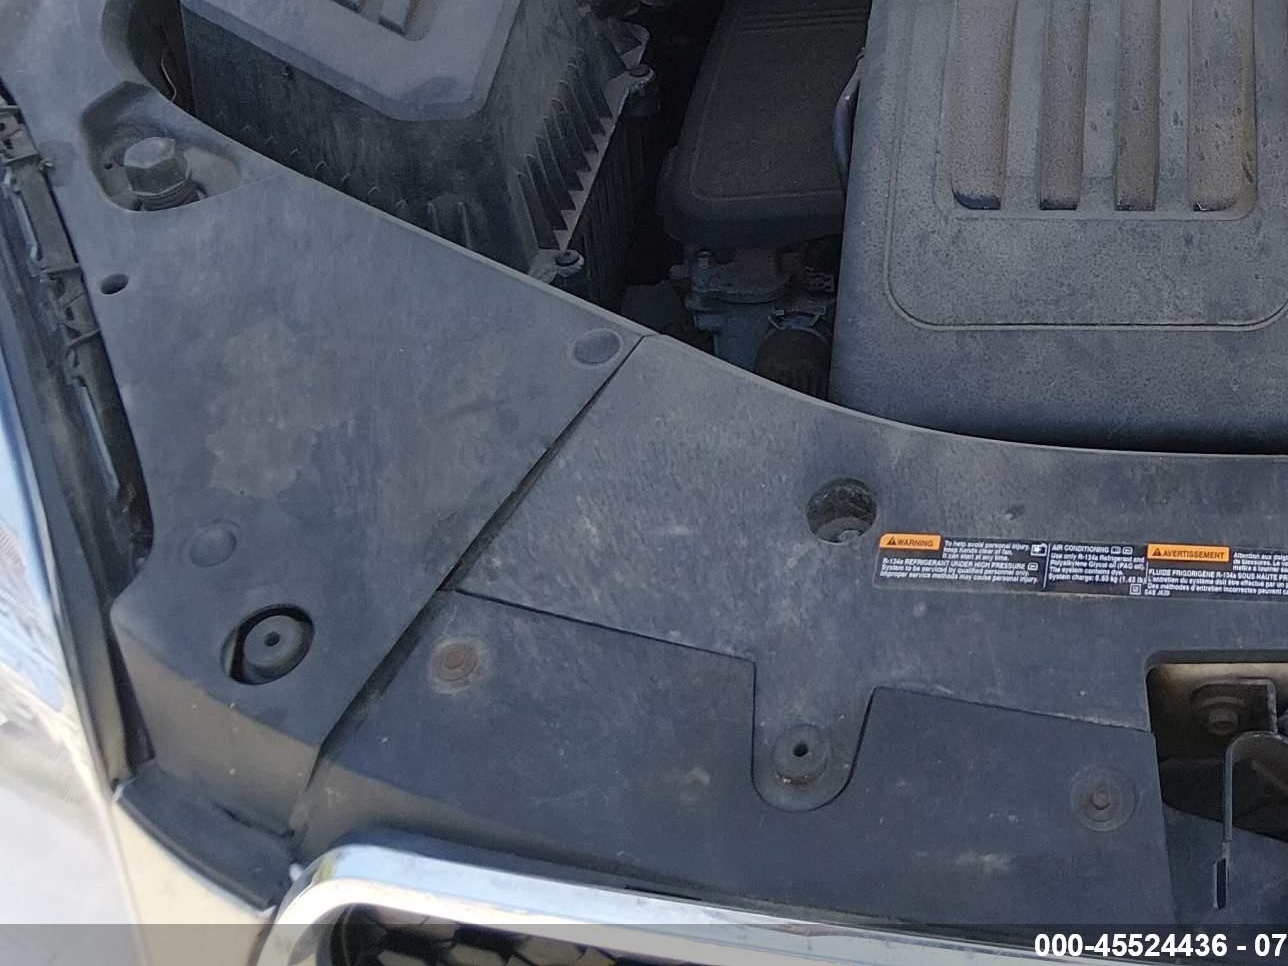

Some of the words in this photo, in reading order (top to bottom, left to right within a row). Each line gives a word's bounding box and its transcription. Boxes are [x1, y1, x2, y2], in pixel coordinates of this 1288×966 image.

[897, 538, 933, 547] WARNING
[952, 540, 966, 548] help
[984, 542, 1011, 550] personal
[1064, 544, 1108, 552] CONDITIONING
[1063, 553, 1076, 561] only
[1163, 549, 1225, 559] AVERTISSEMENT
[904, 558, 950, 566] REFRIGERANT
[1088, 561, 1107, 569] Glycol
[881, 564, 904, 572] System
[957, 567, 982, 575] qualified
[984, 569, 1014, 577] personnel
[1061, 567, 1083, 575] system
[1110, 569, 1123, 577] dye.
[880, 570, 908, 578] Improper
[992, 575, 1018, 583] personal
[1048, 572, 1070, 581] System
[1072, 573, 1094, 582] charge:
[1110, 575, 1118, 583] kg
[1257, 588, 1282, 596] peuvent
